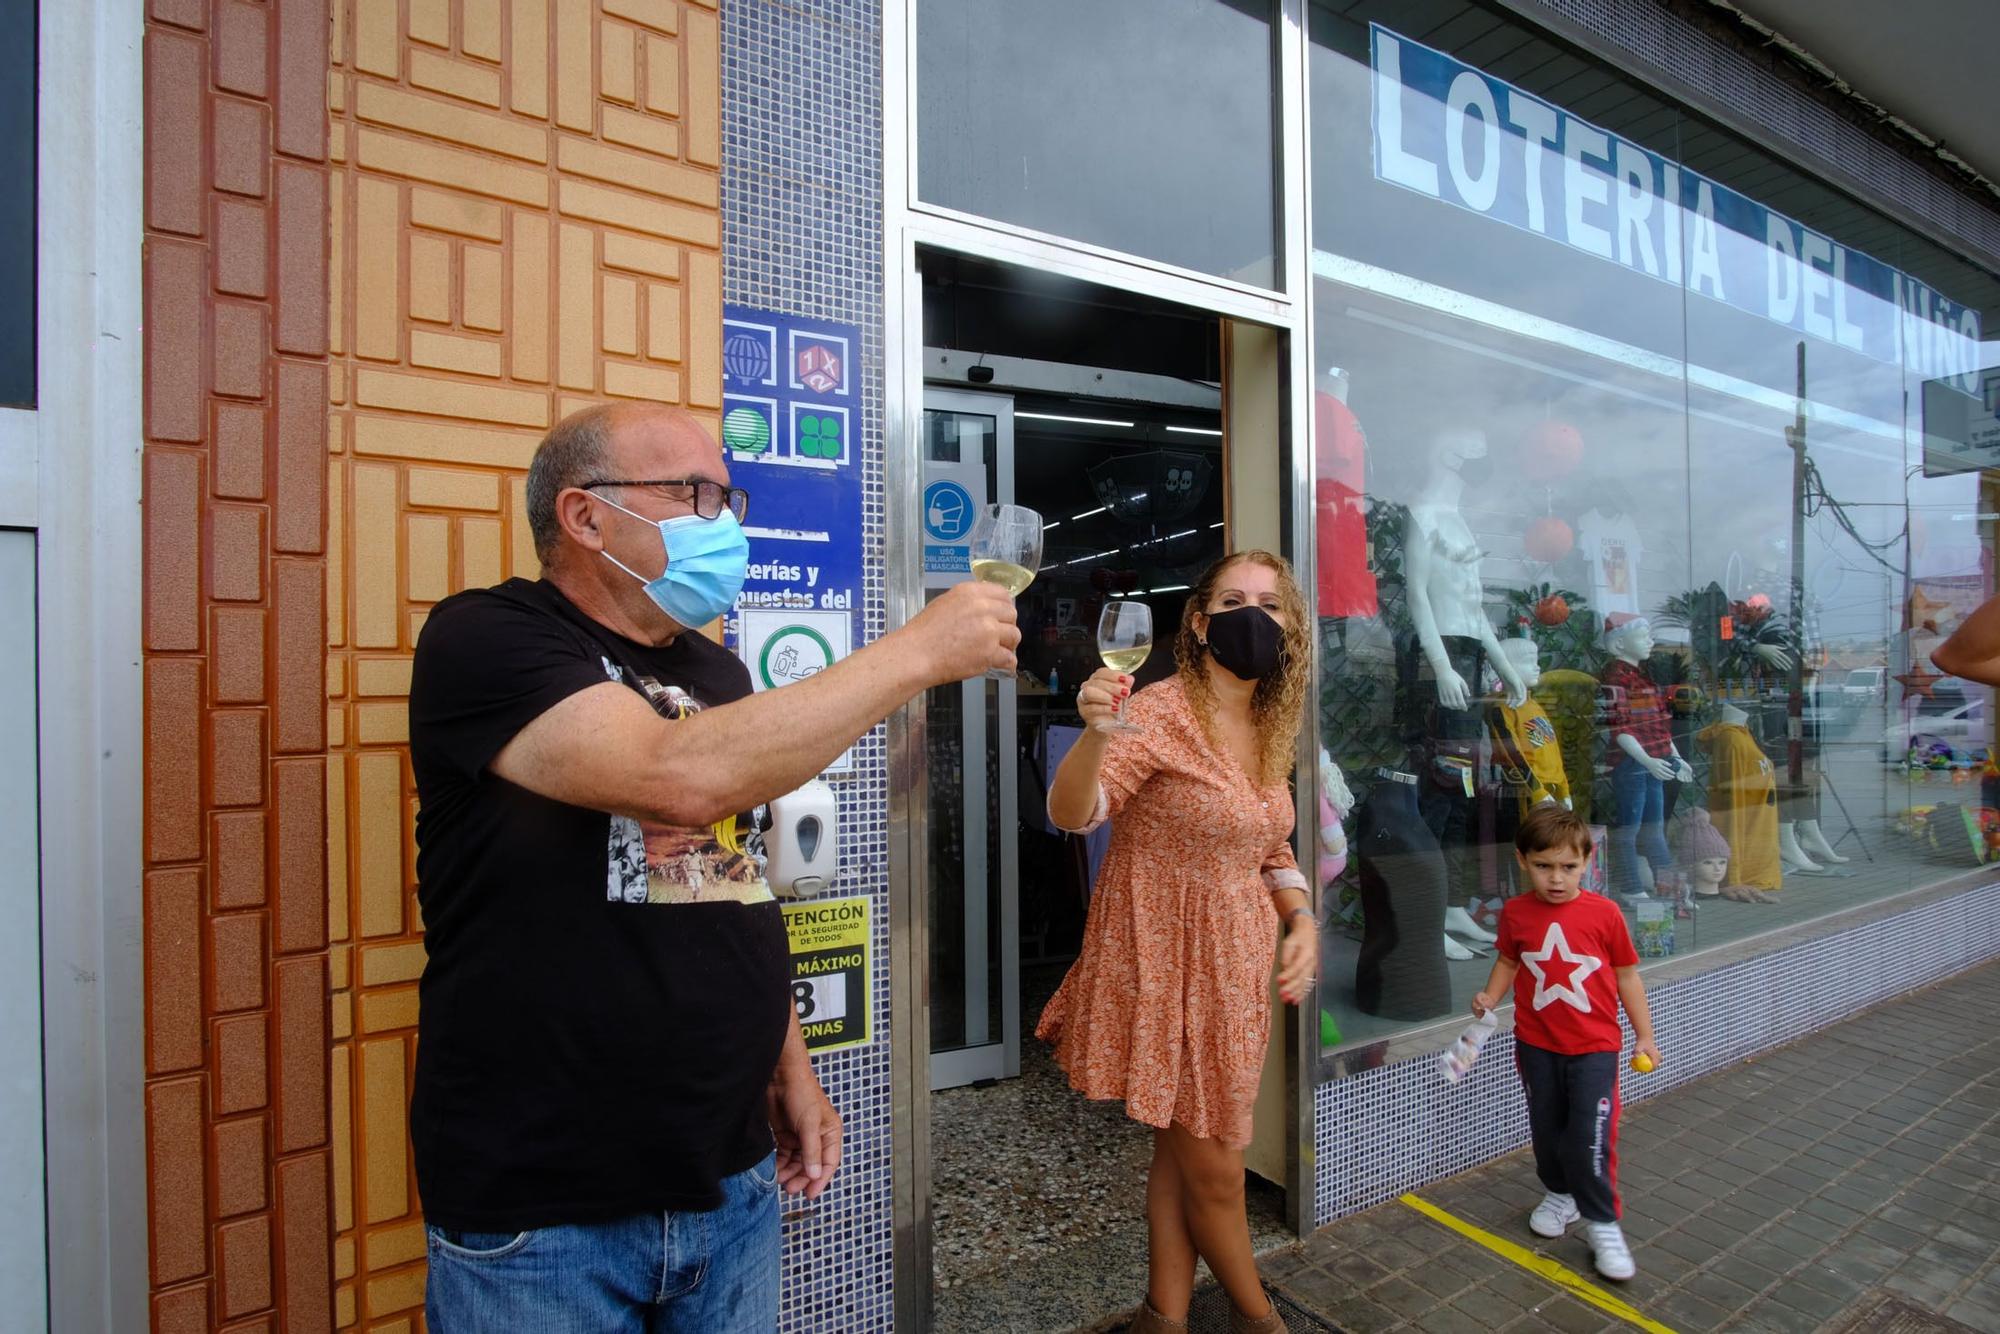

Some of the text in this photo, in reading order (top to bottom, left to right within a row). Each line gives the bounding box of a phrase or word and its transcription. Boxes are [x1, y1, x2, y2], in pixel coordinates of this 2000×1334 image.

[1376, 31, 1980, 394] LOTERIA DEL NIÑO
[803, 351, 836, 377] 1 X
[810, 374, 833, 390] 2
[925, 555, 970, 563] OBLIGATORIO
[940, 548, 955, 556] USO
[744, 560, 819, 587] terías y
[733, 588, 852, 612] puestas del
[783, 903, 864, 927] TENCIÓN
[811, 922, 860, 935] SEGURIDAD
[800, 934, 842, 945] DE TODOS
[797, 954, 862, 975] MÁXIMO
[801, 1020, 844, 1039] ONAS
[1589, 1097, 1611, 1177] Champion
